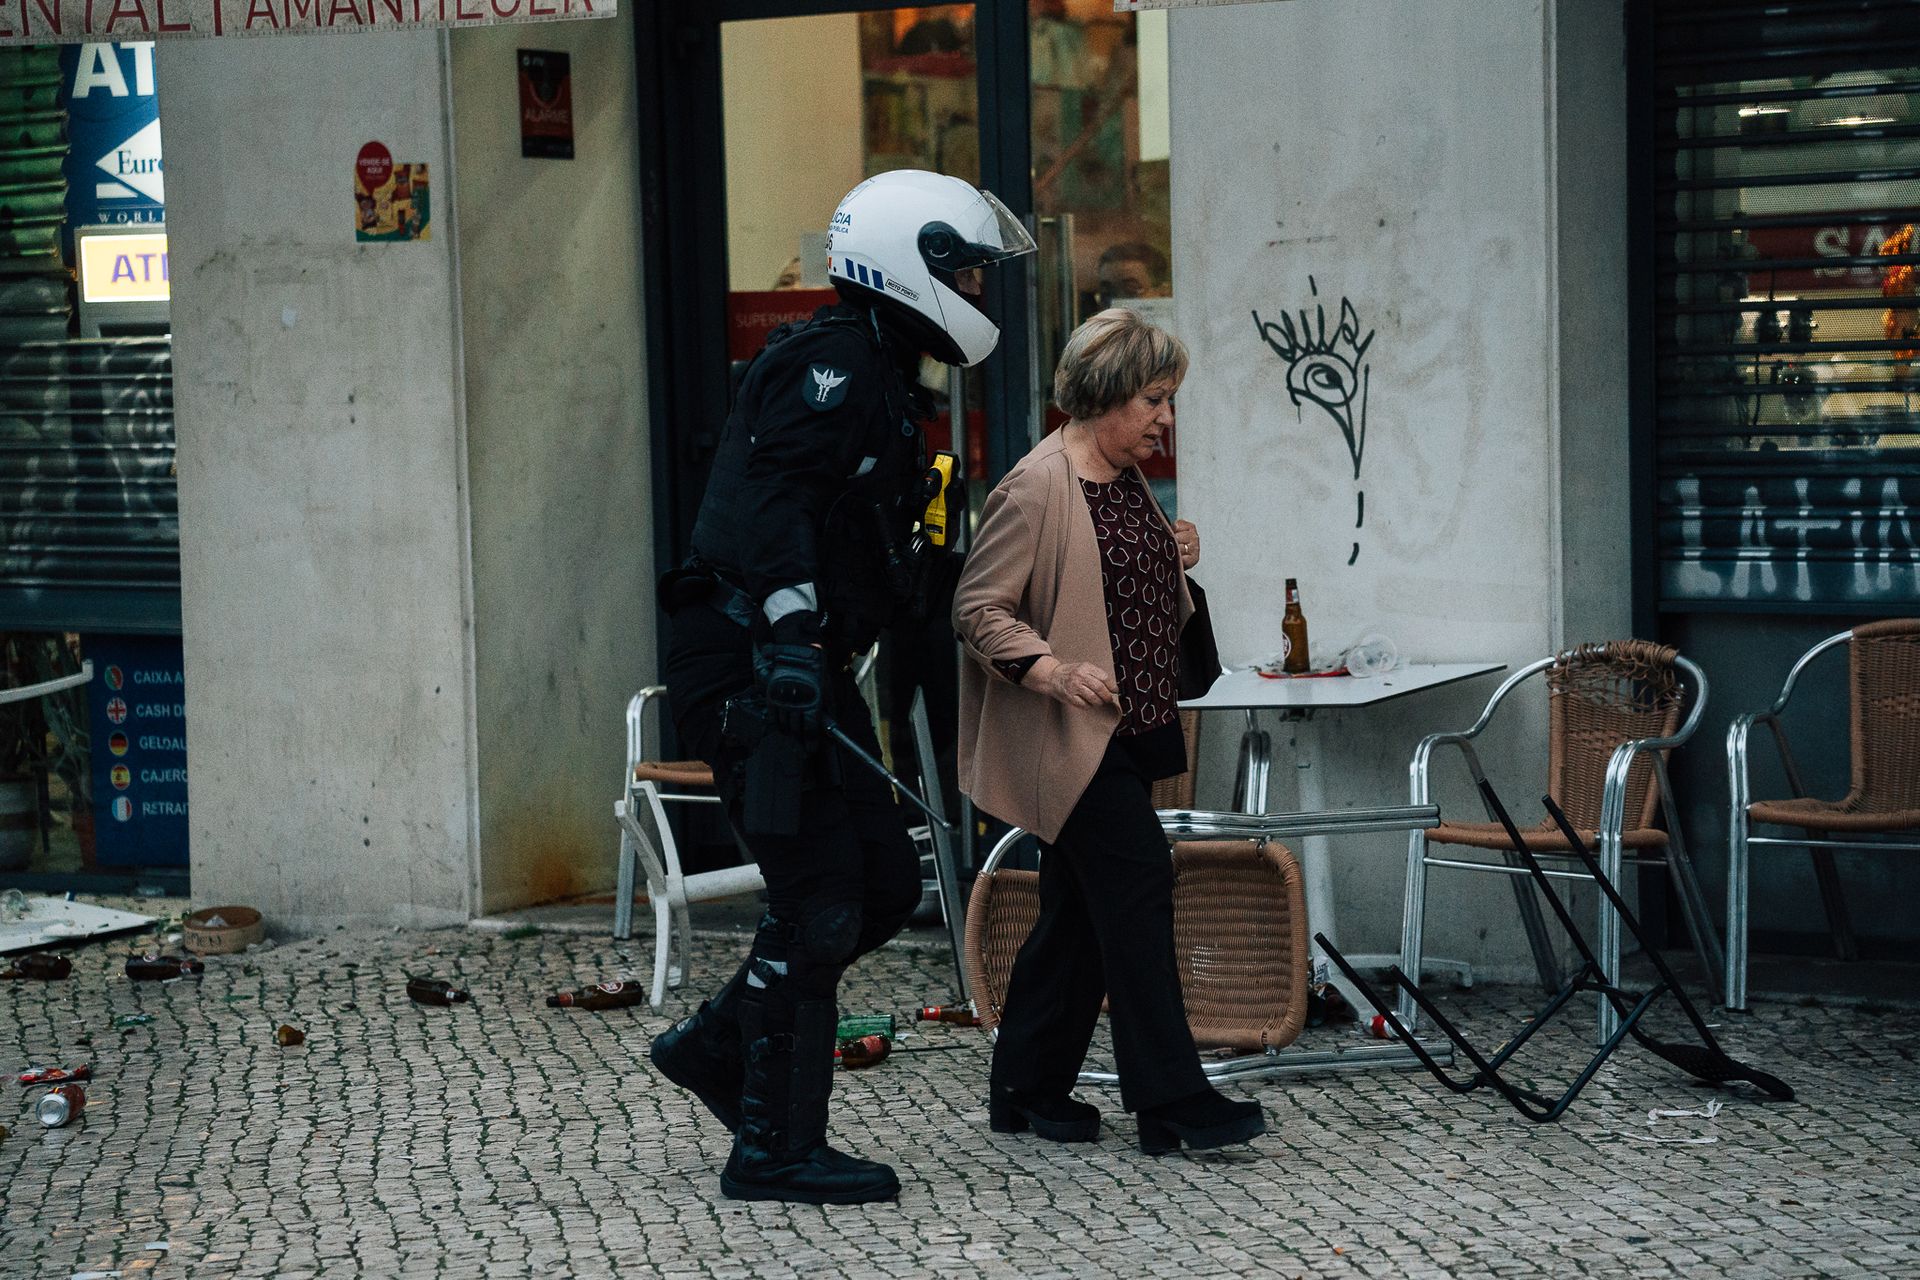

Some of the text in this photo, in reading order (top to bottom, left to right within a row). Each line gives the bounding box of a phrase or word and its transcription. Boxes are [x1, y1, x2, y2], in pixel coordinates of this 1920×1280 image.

[134, 670, 172, 684] CAIXA
[136, 704, 185, 718] CASH D
[142, 801, 189, 816] RETRAI
